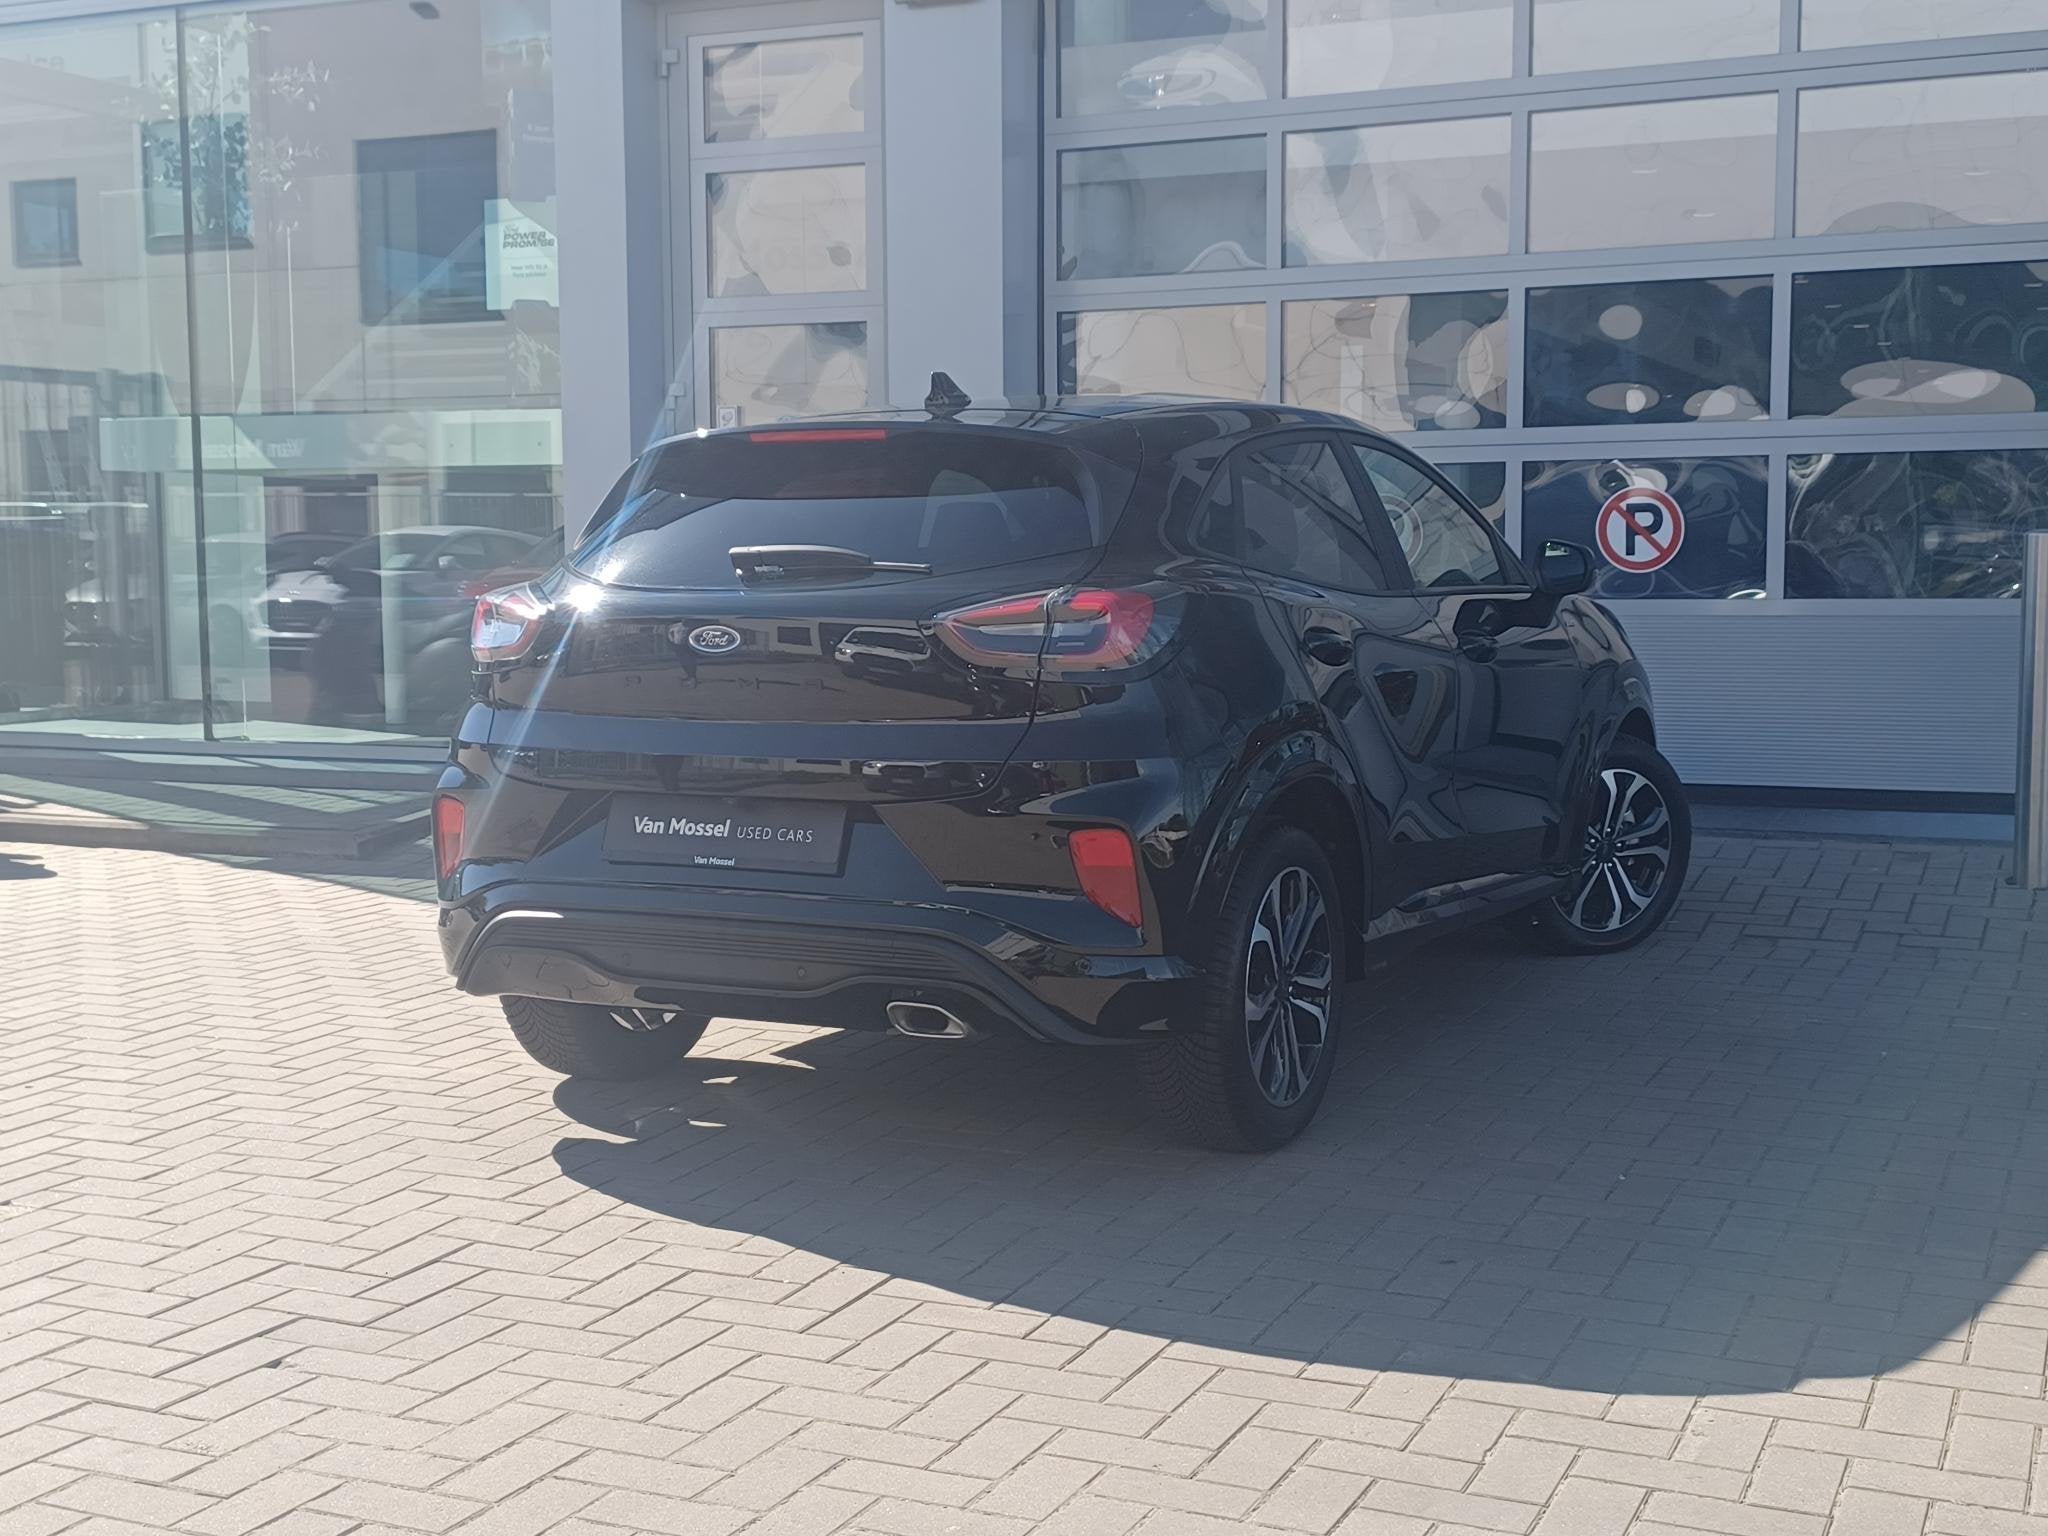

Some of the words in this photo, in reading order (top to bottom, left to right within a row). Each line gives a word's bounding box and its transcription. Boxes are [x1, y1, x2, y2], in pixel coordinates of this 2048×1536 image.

[504, 231, 546, 241] POWER
[1626, 502, 1664, 556] P
[699, 630, 729, 646] Ford
[633, 815, 664, 834] Van
[668, 817, 731, 837] Mossel
[736, 826, 772, 841] USED
[777, 828, 814, 843] CARS
[693, 855, 707, 865] Van
[708, 856, 736, 866] Mossel
